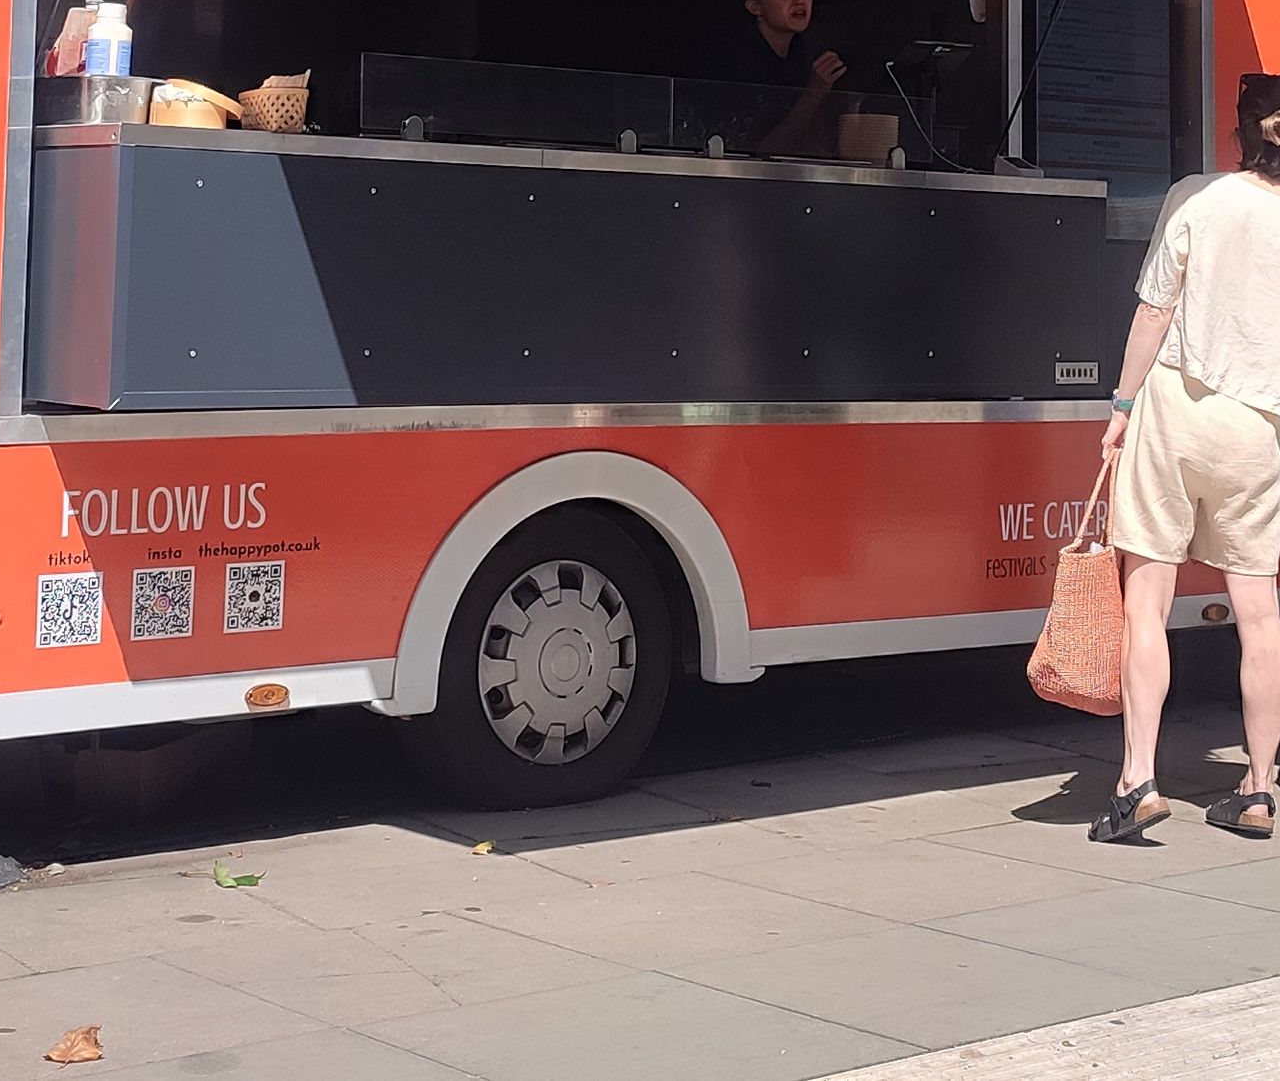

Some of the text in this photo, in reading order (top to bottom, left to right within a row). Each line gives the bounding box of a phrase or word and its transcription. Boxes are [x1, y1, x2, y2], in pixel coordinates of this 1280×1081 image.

[61, 482, 267, 538] FOLLOW US
[999, 502, 1035, 542] WE
[48, 550, 91, 567] tiktok
[148, 547, 183, 560] insta
[198, 538, 320, 561] thehappypot.co.uk
